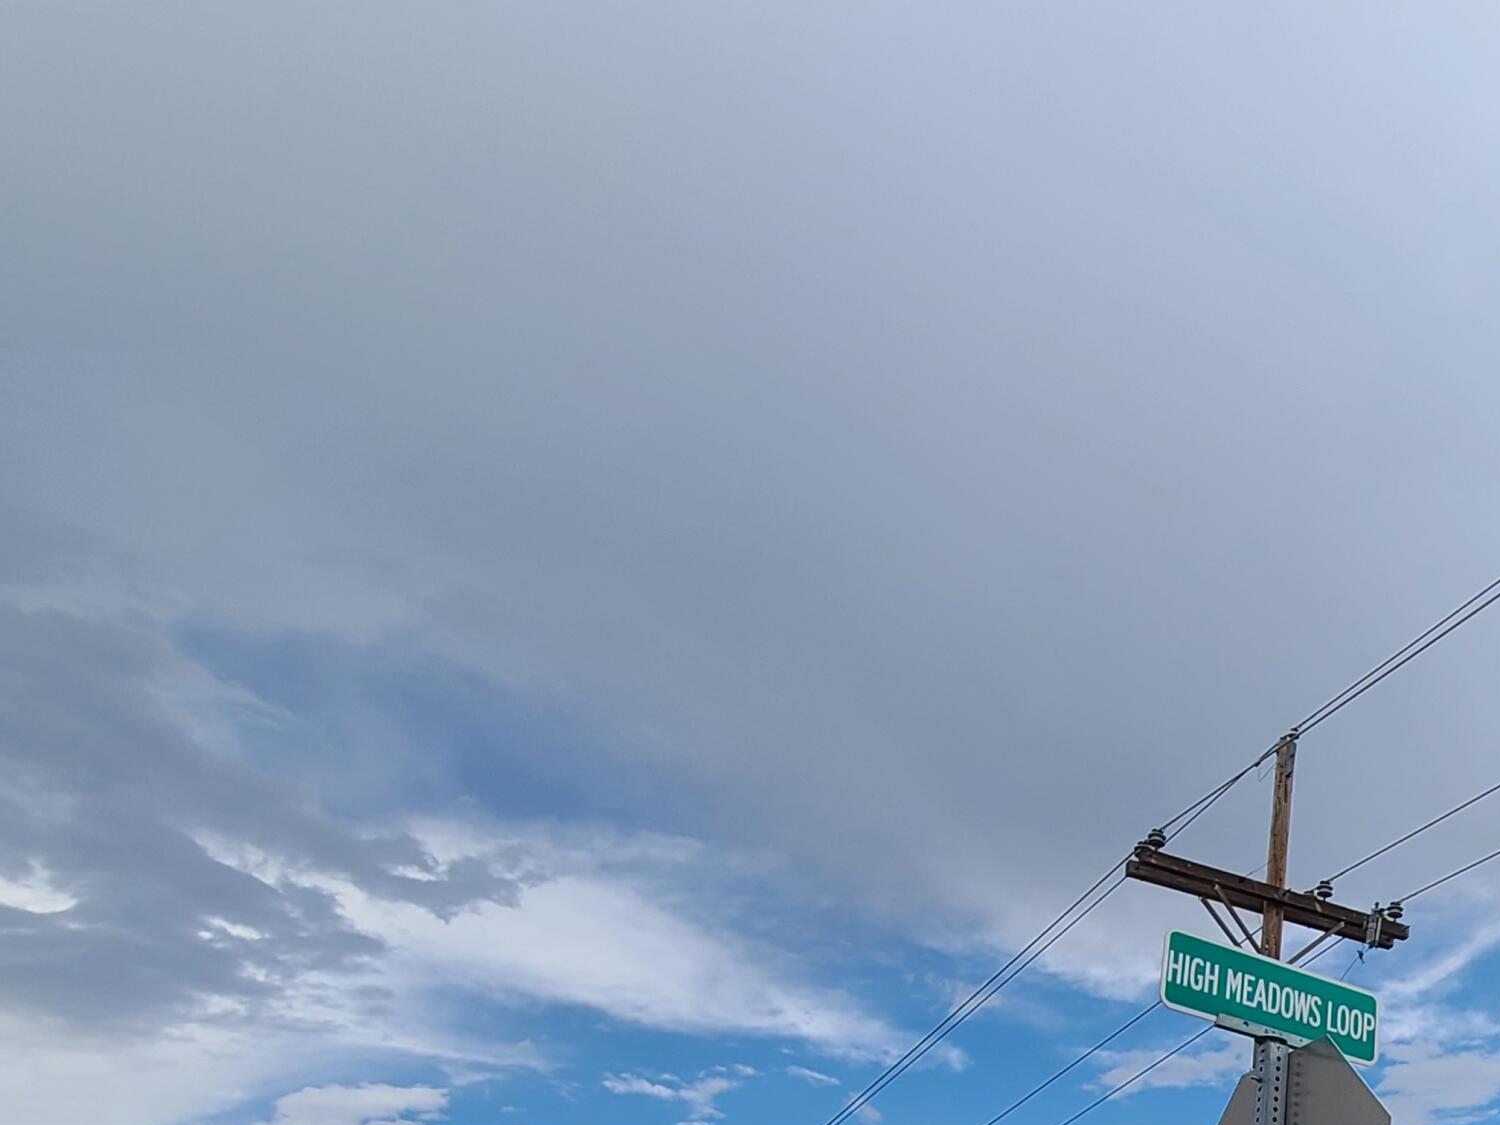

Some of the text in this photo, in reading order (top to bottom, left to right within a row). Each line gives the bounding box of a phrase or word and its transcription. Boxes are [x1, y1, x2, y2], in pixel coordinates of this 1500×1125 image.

[1167, 950, 1375, 1042] HIGH MEADOWS LOOP
